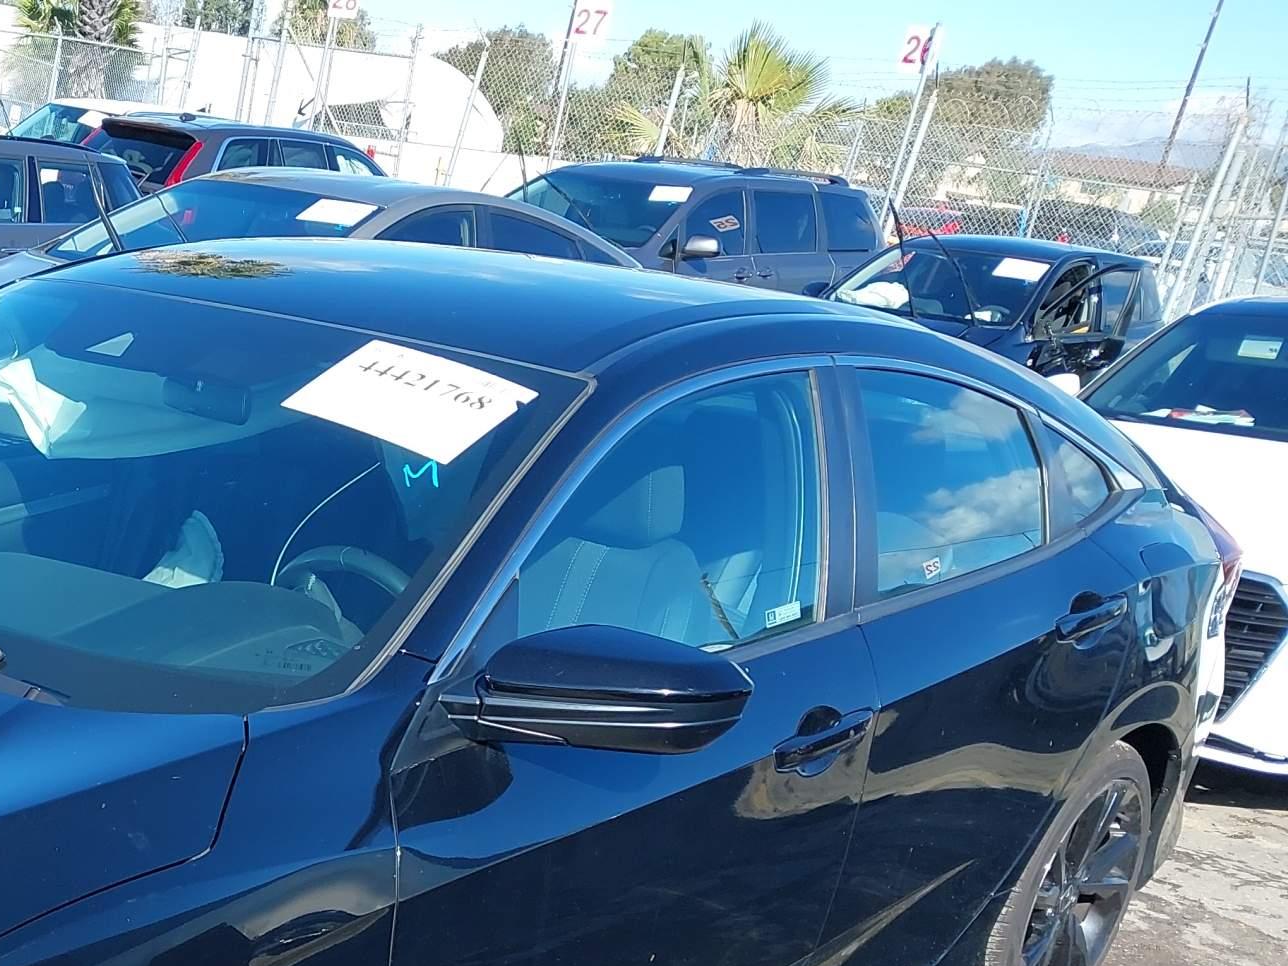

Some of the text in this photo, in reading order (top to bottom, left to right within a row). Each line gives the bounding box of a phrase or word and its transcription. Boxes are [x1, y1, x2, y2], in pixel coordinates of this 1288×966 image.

[574, 9, 608, 35] 27
[359, 360, 492, 410] 44421768
[402, 459, 439, 488] M
